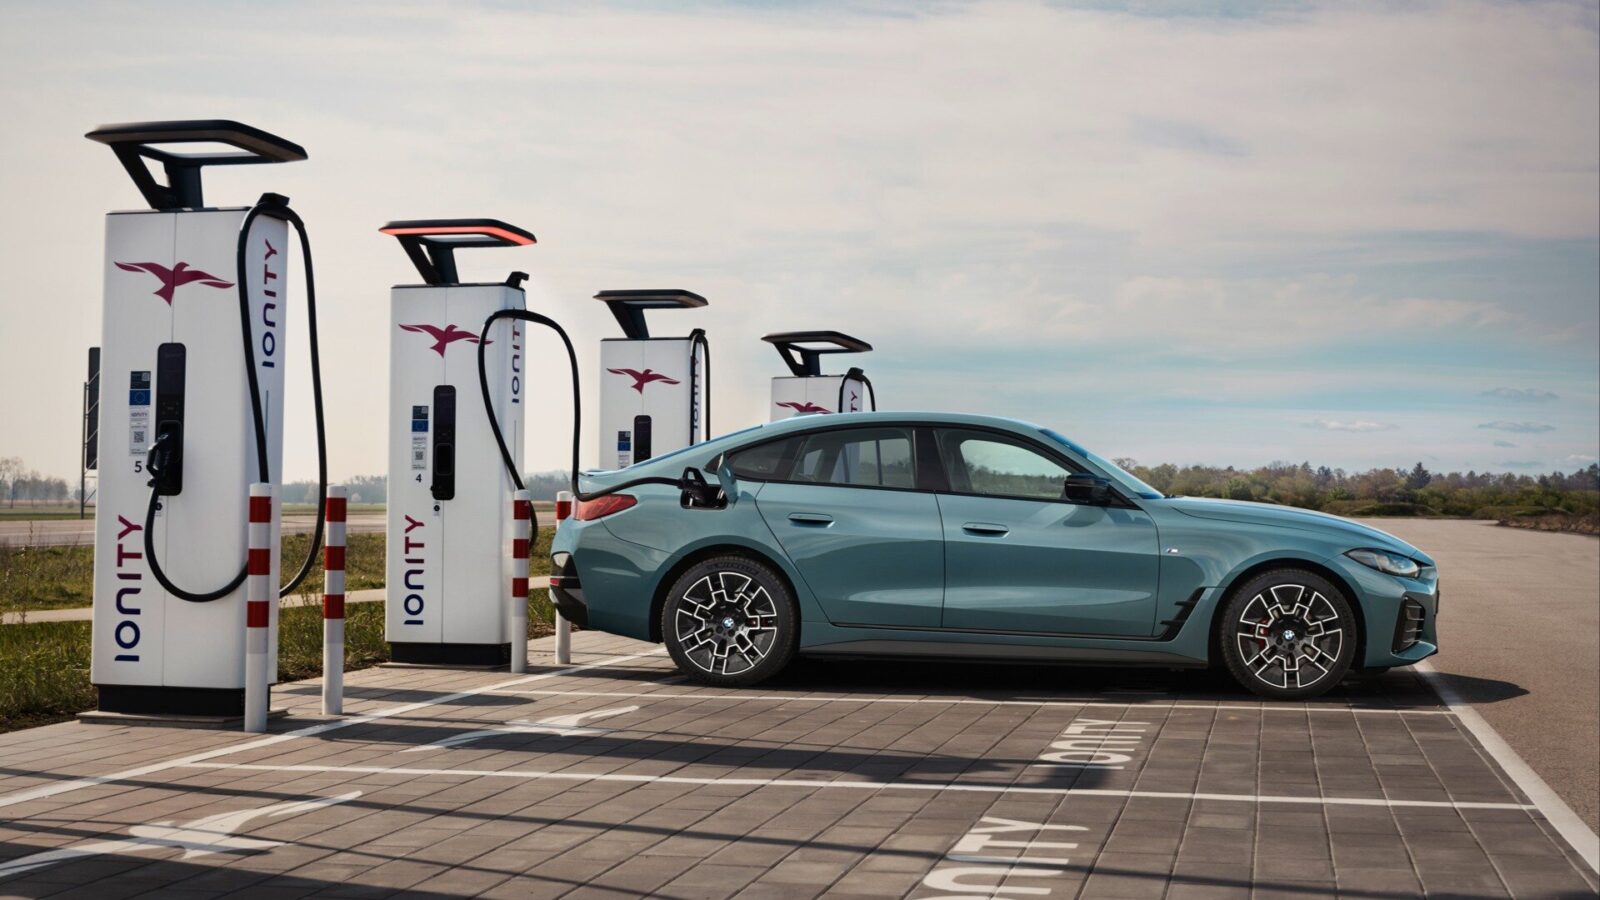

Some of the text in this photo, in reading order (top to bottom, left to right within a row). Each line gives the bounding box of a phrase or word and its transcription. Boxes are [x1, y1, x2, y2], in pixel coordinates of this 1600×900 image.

[512, 307, 520, 404] IONIT
[134, 460, 143, 473] 5
[415, 473, 422, 483] 4
[912, 816, 1090, 900] NITY
